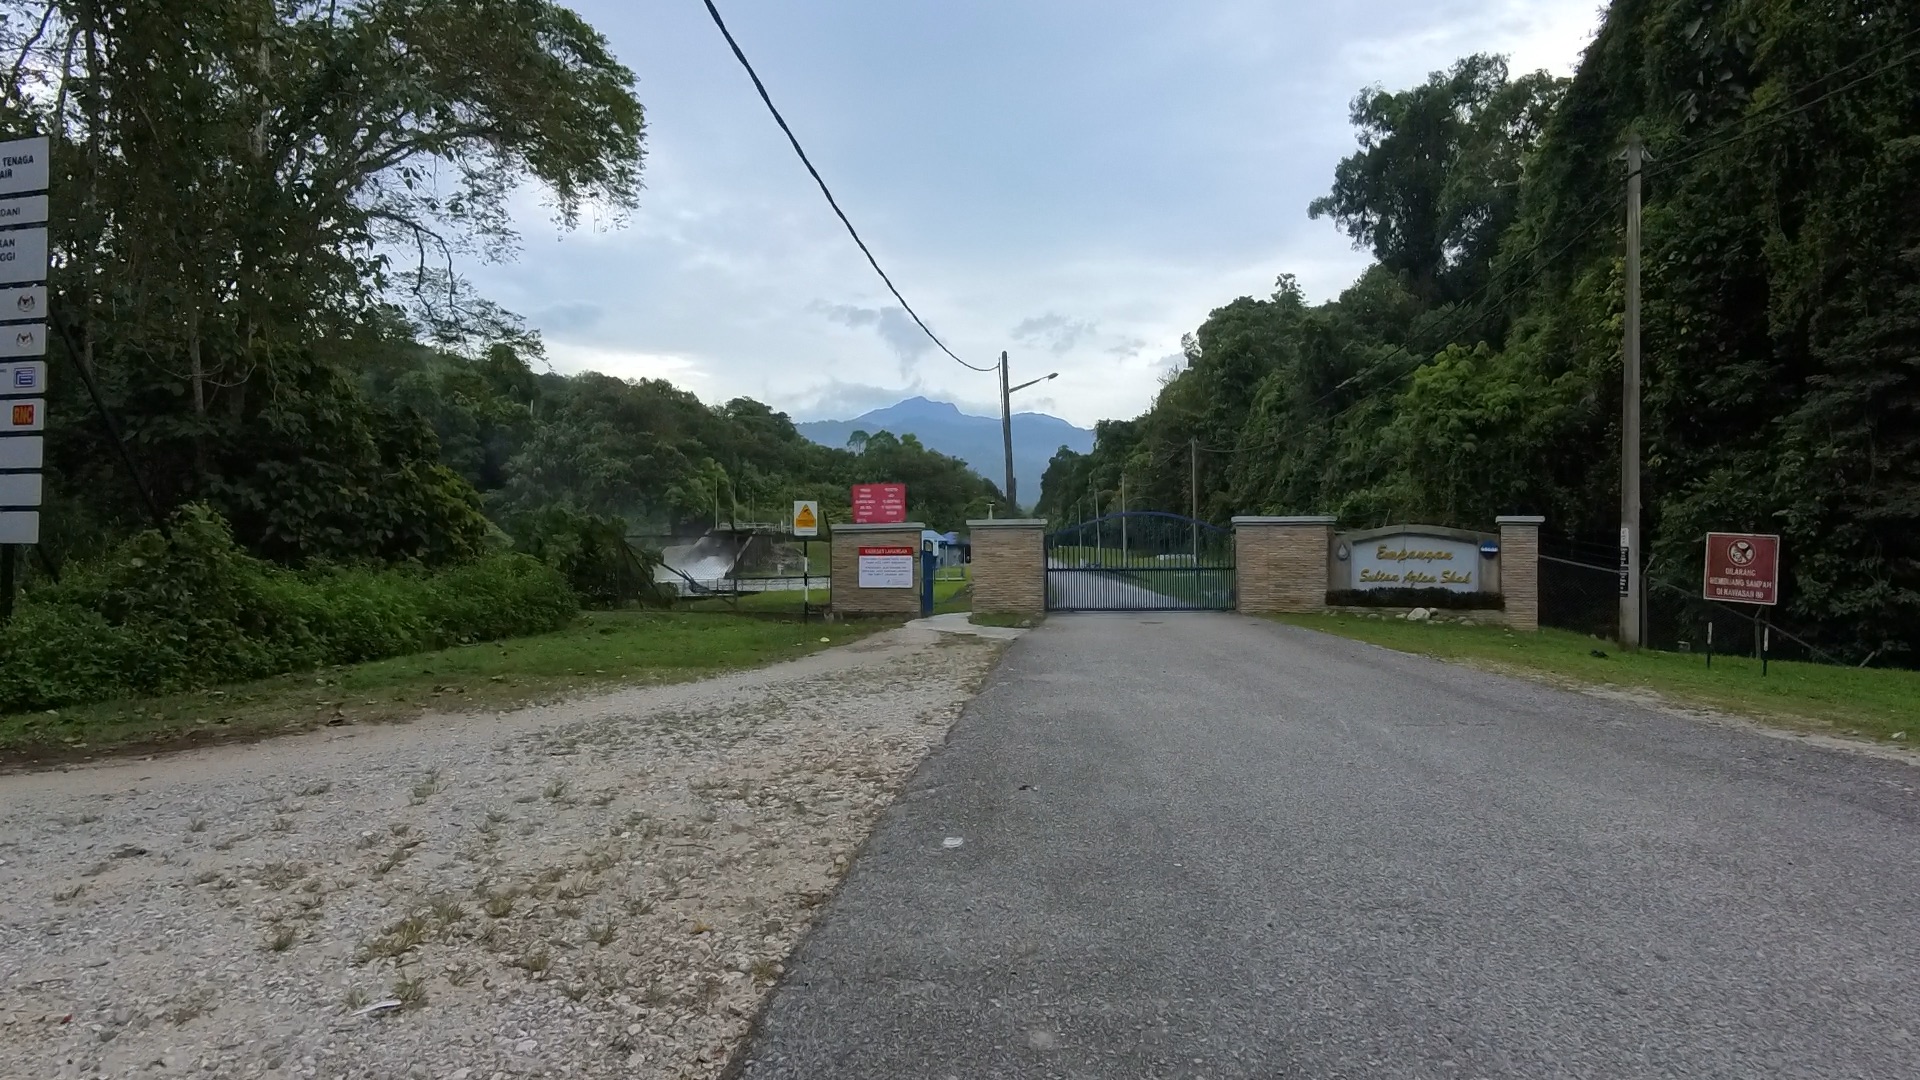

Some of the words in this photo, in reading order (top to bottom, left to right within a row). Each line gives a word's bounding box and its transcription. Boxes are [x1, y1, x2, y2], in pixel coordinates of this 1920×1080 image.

[2, 155, 34, 167] TENAGA
[0, 168, 13, 179] AIR
[1376, 544, 1454, 563] Empangan
[1360, 568, 1400, 582] Sultan
[1440, 570, 1472, 584] Shah
[1725, 567, 1756, 576] DILARANG
[1723, 588, 1755, 597] KAWASAN
